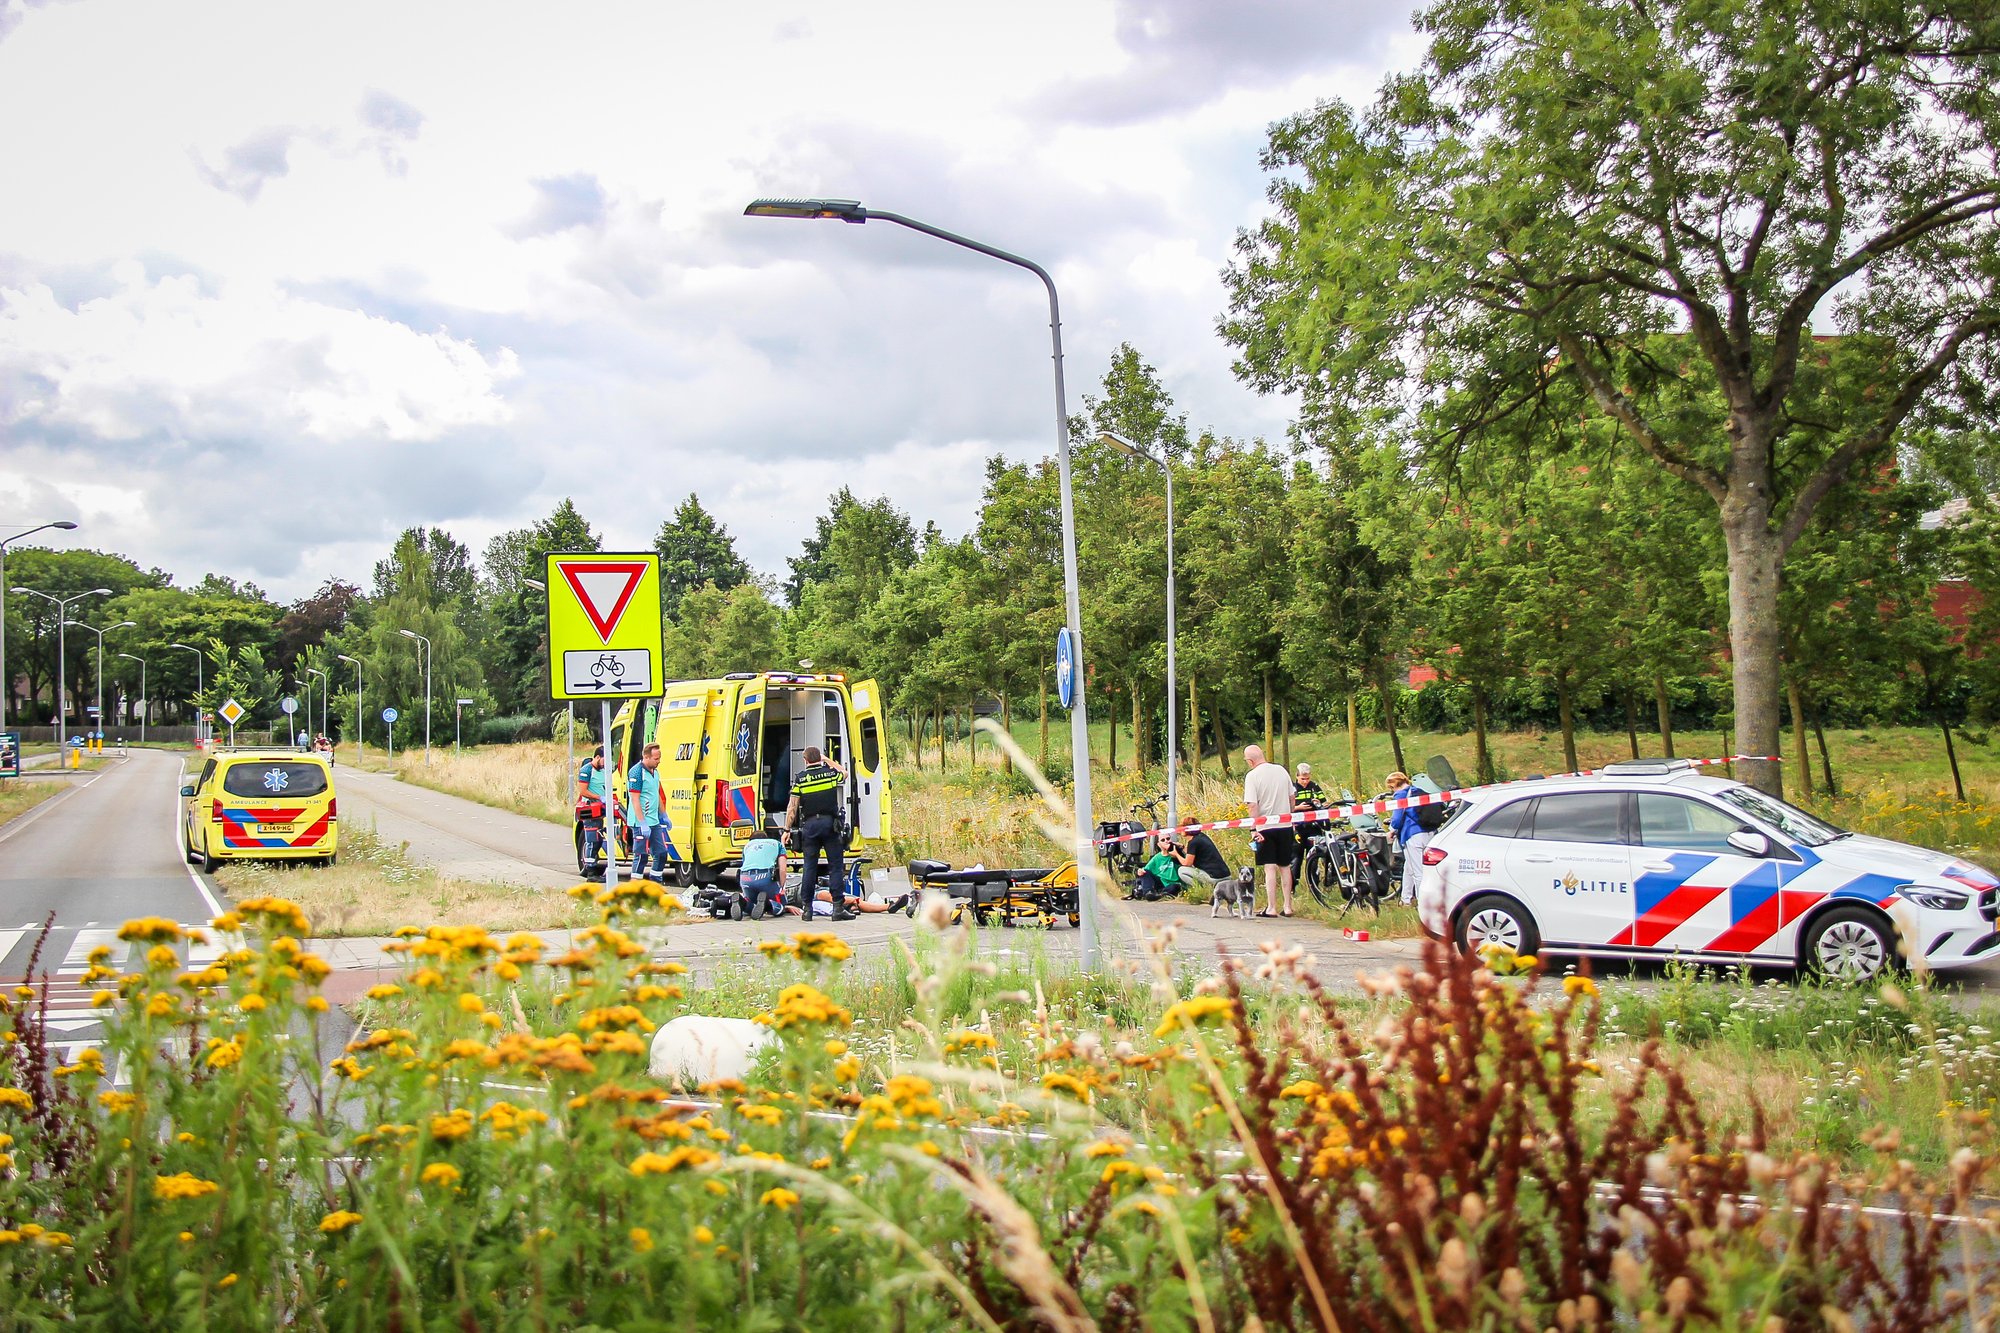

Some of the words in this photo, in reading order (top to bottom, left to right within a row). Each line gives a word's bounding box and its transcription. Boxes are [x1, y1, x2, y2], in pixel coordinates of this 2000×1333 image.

[671, 789, 694, 800] AMBUL
[1475, 860, 1491, 869] 112
[1553, 878, 1627, 896] POLITIE
